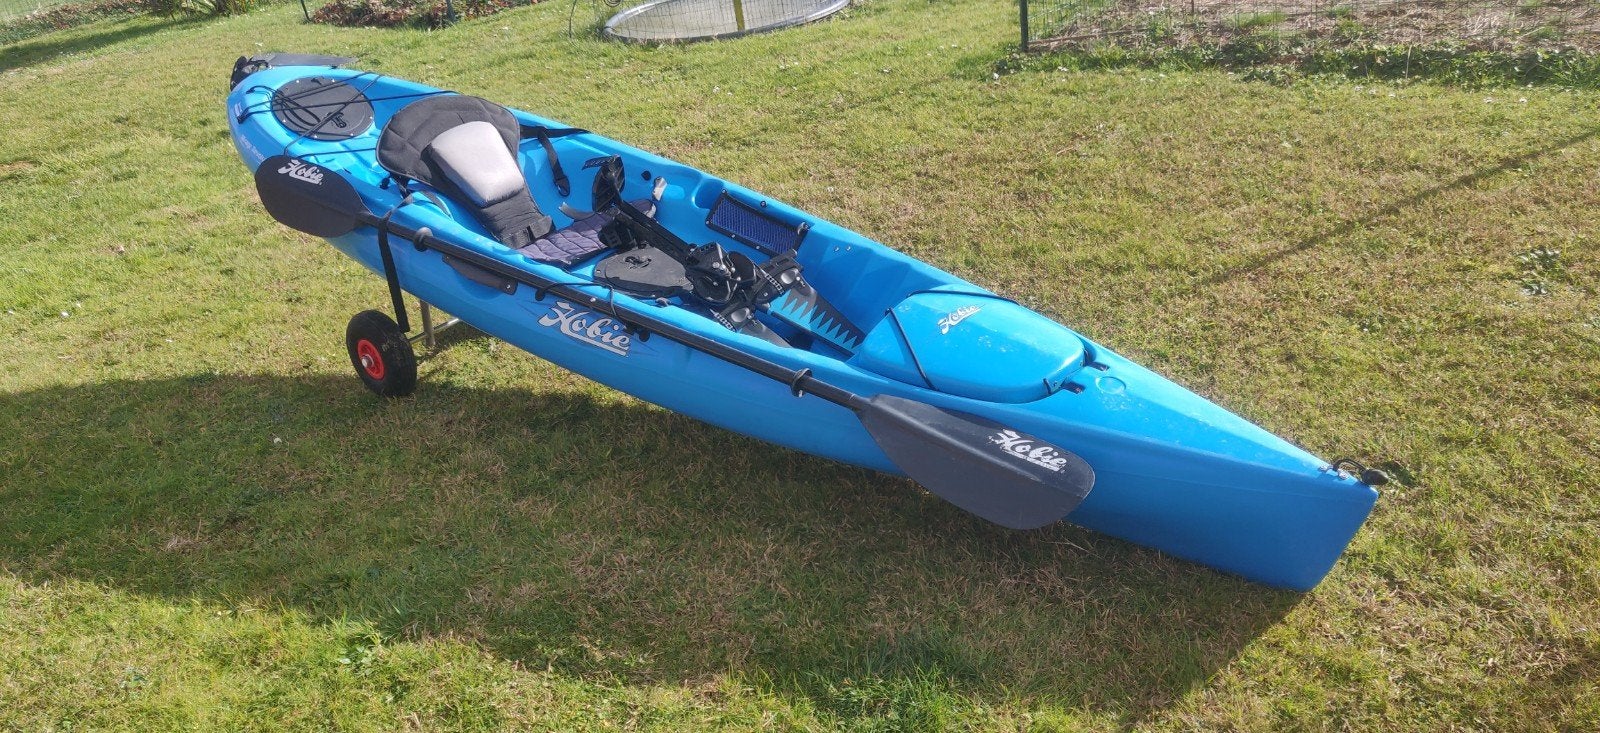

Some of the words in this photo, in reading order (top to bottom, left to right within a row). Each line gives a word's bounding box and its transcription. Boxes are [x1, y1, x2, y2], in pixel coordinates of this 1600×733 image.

[278, 159, 323, 184] Hobie
[538, 301, 630, 356] Hobie
[937, 305, 981, 335] Hobie
[987, 428, 1067, 472] Hobie
